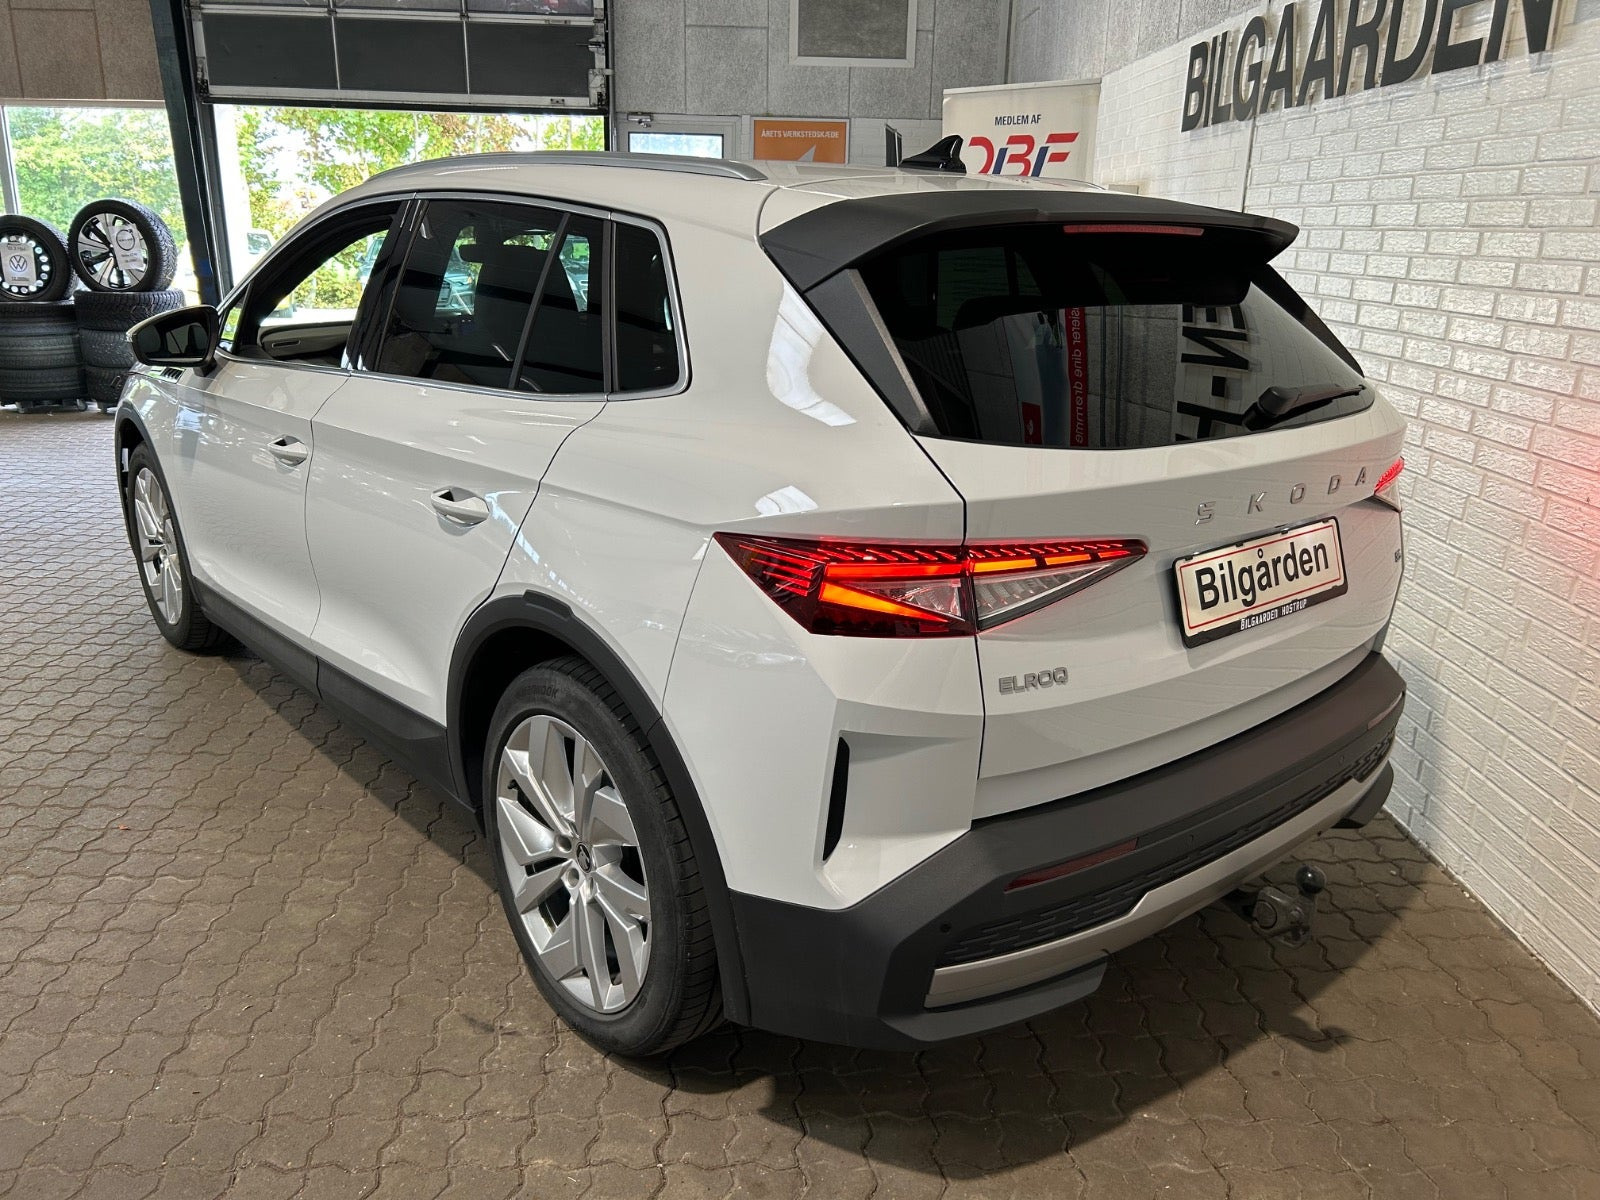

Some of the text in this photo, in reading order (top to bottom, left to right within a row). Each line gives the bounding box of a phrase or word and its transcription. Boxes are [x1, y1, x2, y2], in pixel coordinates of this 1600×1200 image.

[994, 114, 1042, 126] MEDLEM AF
[761, 128, 781, 138] ÅRETS
[1195, 542, 1329, 611] Bilgården
[1240, 609, 1279, 631] BILGAARDEN
[998, 667, 1069, 695] ELROQ
